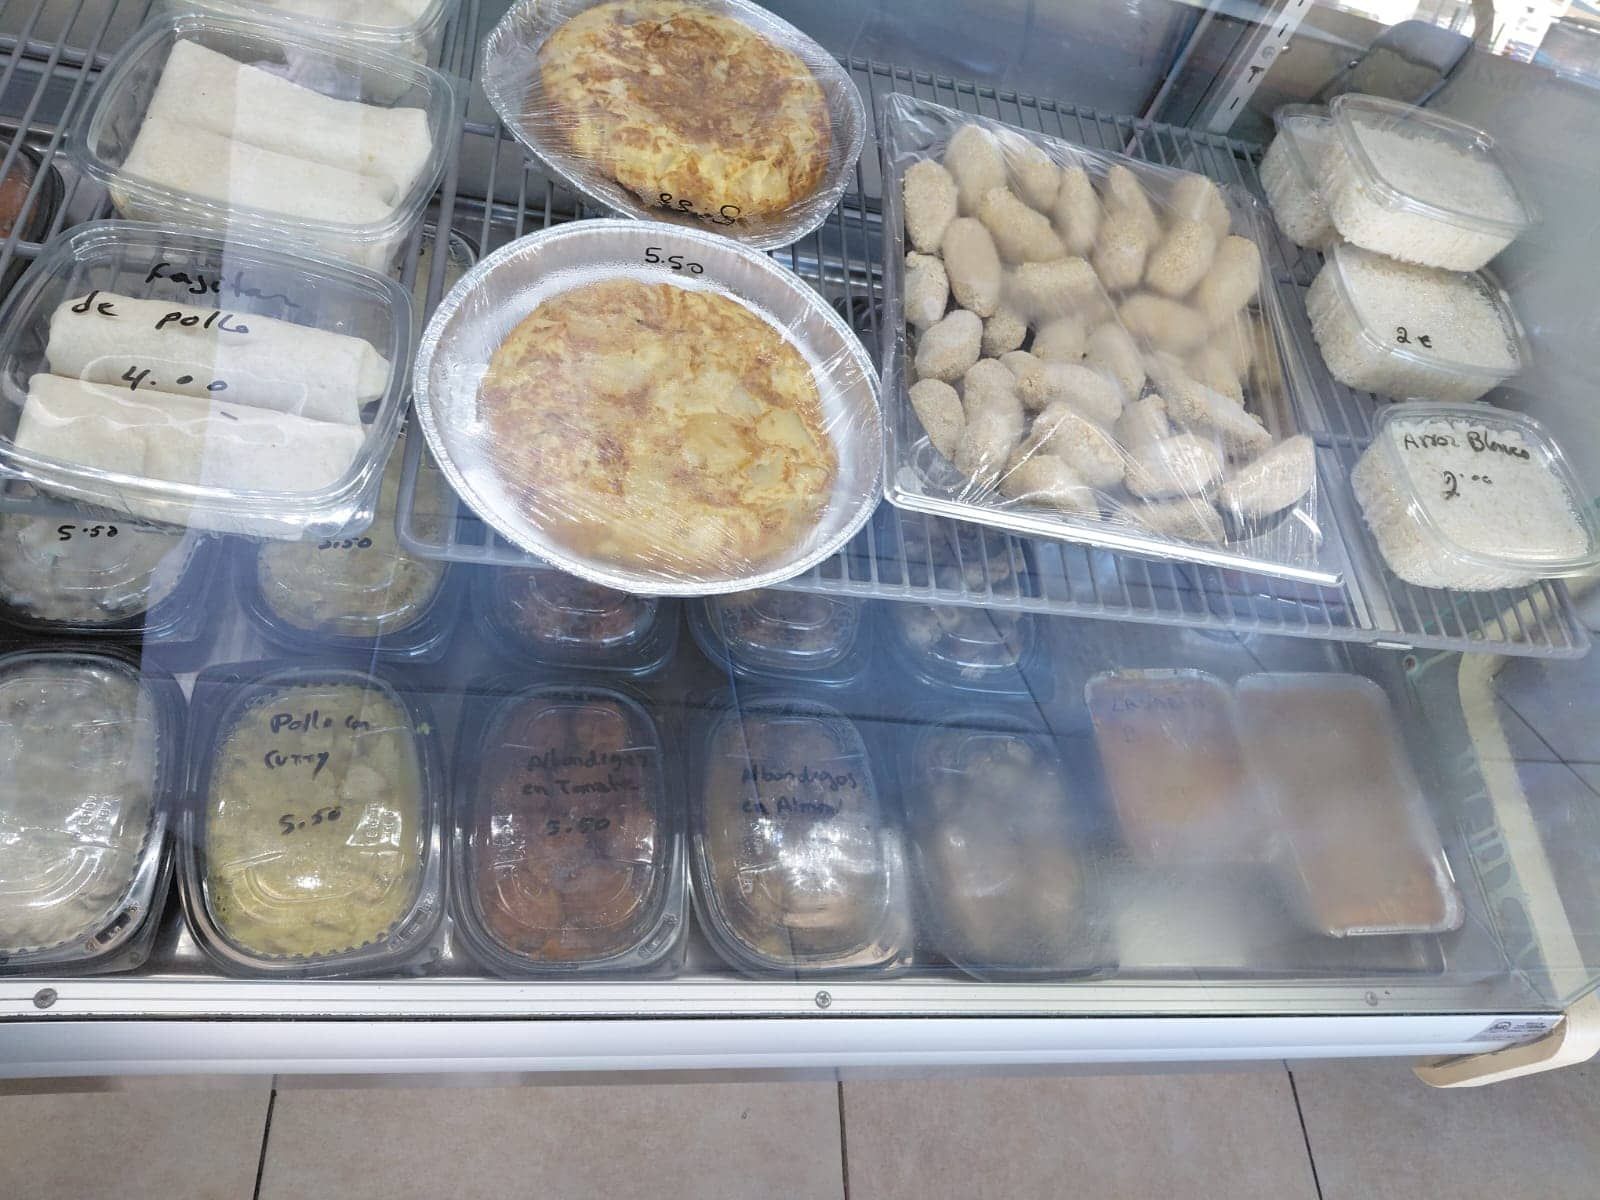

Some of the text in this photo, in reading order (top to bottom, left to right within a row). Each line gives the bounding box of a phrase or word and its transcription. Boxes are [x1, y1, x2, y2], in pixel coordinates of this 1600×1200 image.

[645, 247, 704, 274] 5.50
[72, 291, 119, 316] de
[57, 525, 118, 541] 5.50
[270, 710, 333, 733] Pollo
[279, 806, 342, 836] 5.50
